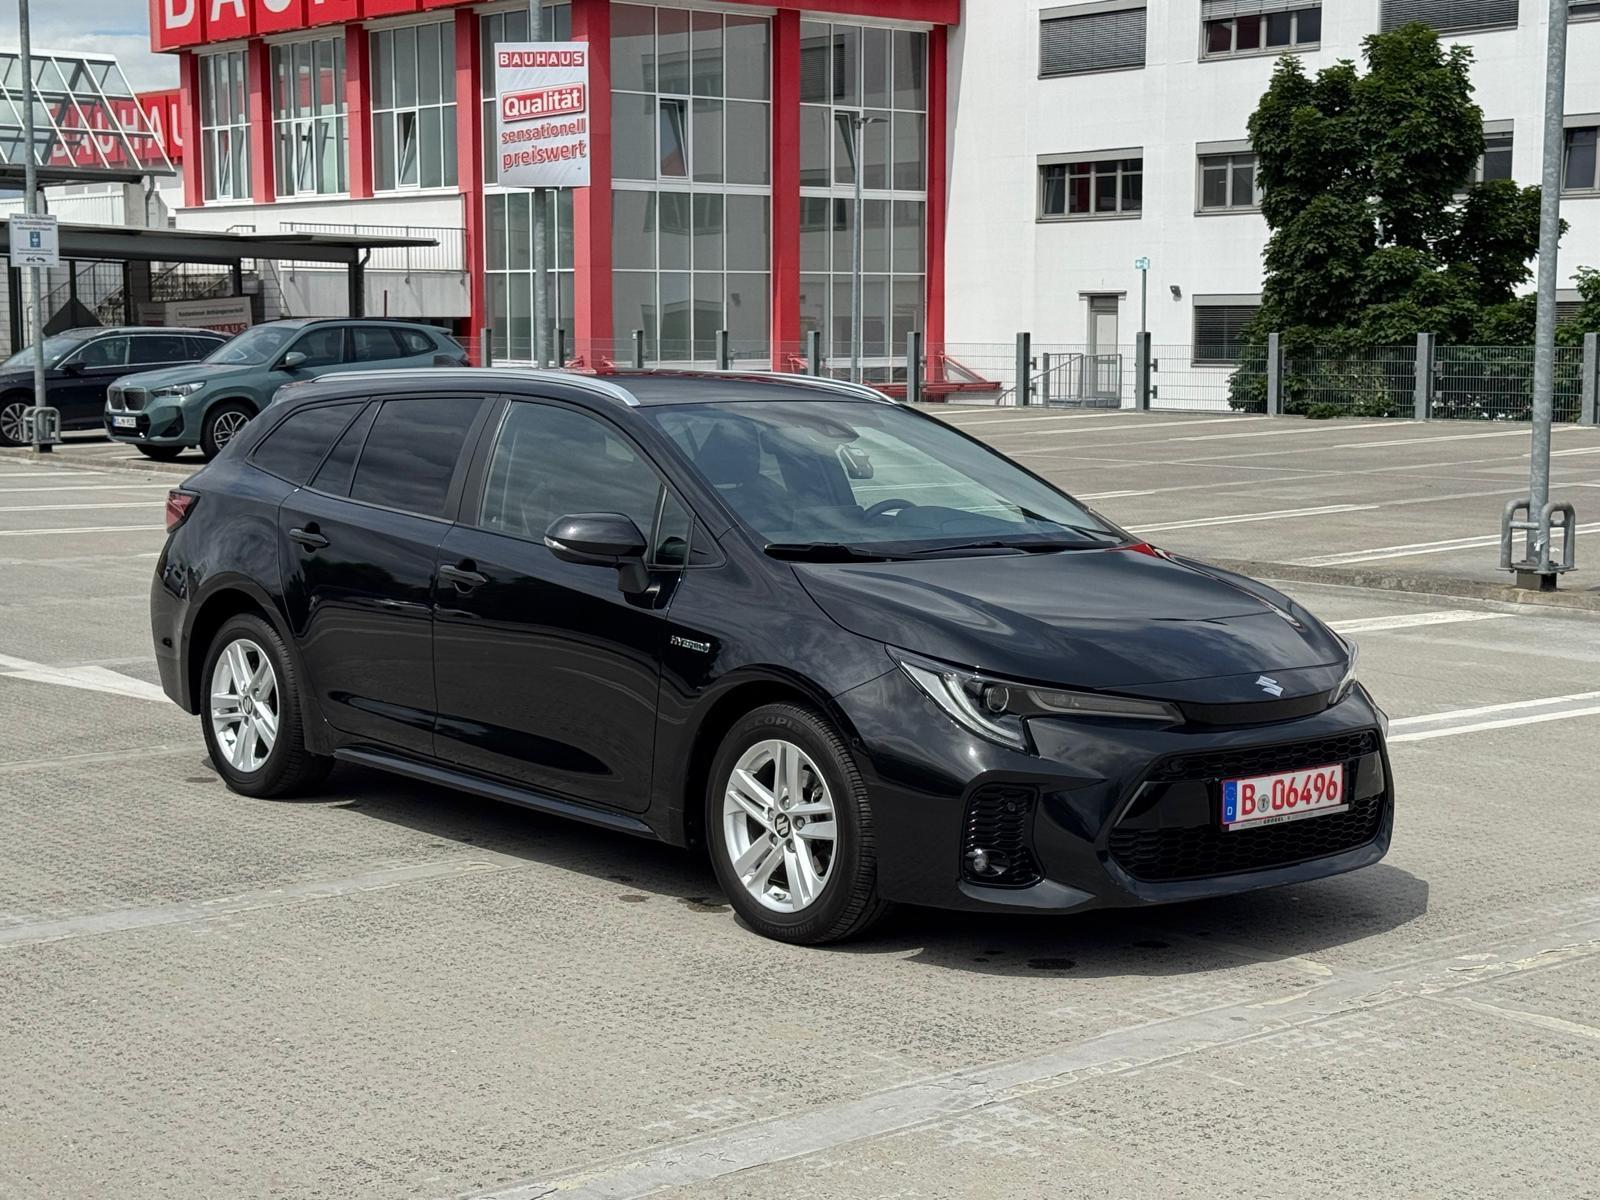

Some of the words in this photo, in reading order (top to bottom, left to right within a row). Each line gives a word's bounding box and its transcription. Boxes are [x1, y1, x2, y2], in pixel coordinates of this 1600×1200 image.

[500, 52, 583, 66] BAUHAUS
[504, 88, 580, 117] Qualität
[501, 118, 586, 144] sensationell
[503, 140, 586, 172] preiswert
[1241, 783, 1256, 816] B
[1271, 770, 1338, 810] 06496
[1227, 806, 1233, 816] D
